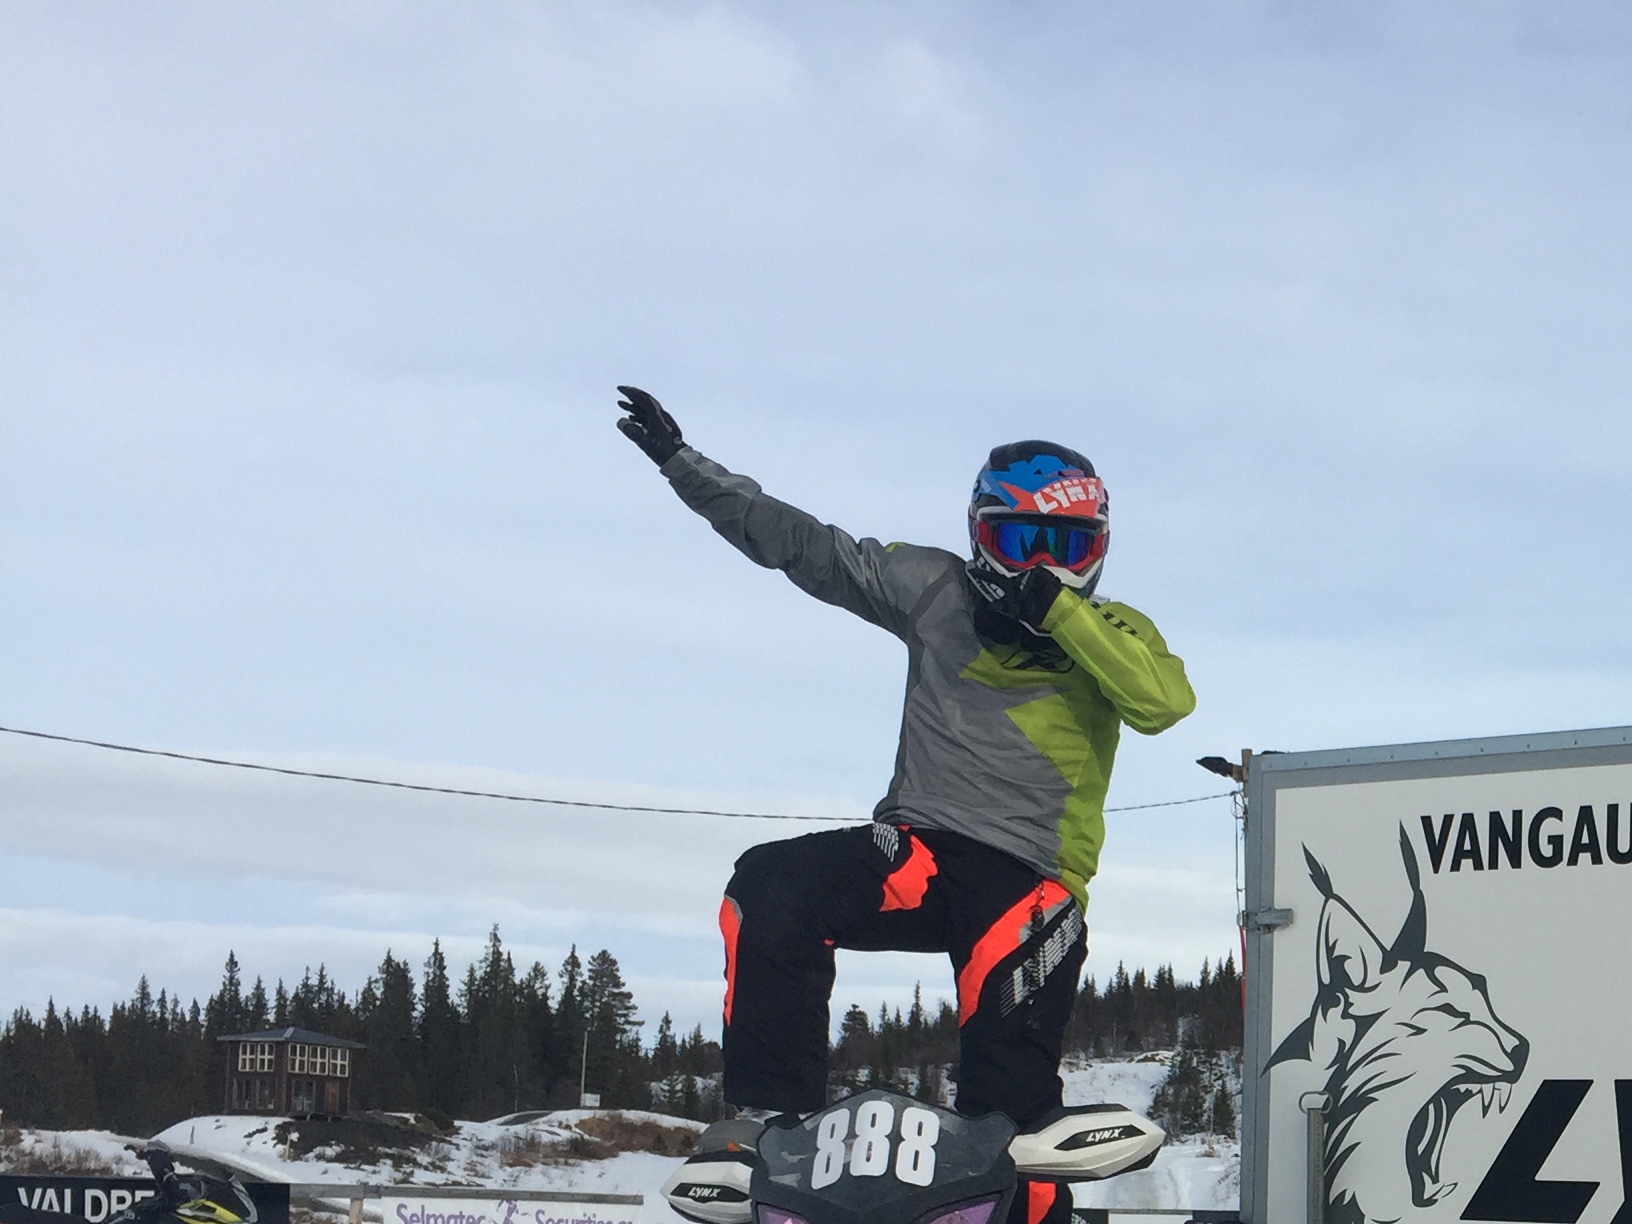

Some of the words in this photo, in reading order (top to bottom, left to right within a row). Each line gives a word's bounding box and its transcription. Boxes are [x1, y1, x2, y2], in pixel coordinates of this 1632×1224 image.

[1085, 1128, 1123, 1143] LYNX
[811, 1100, 940, 1190] 888
[688, 1186, 721, 1198] LYNX
